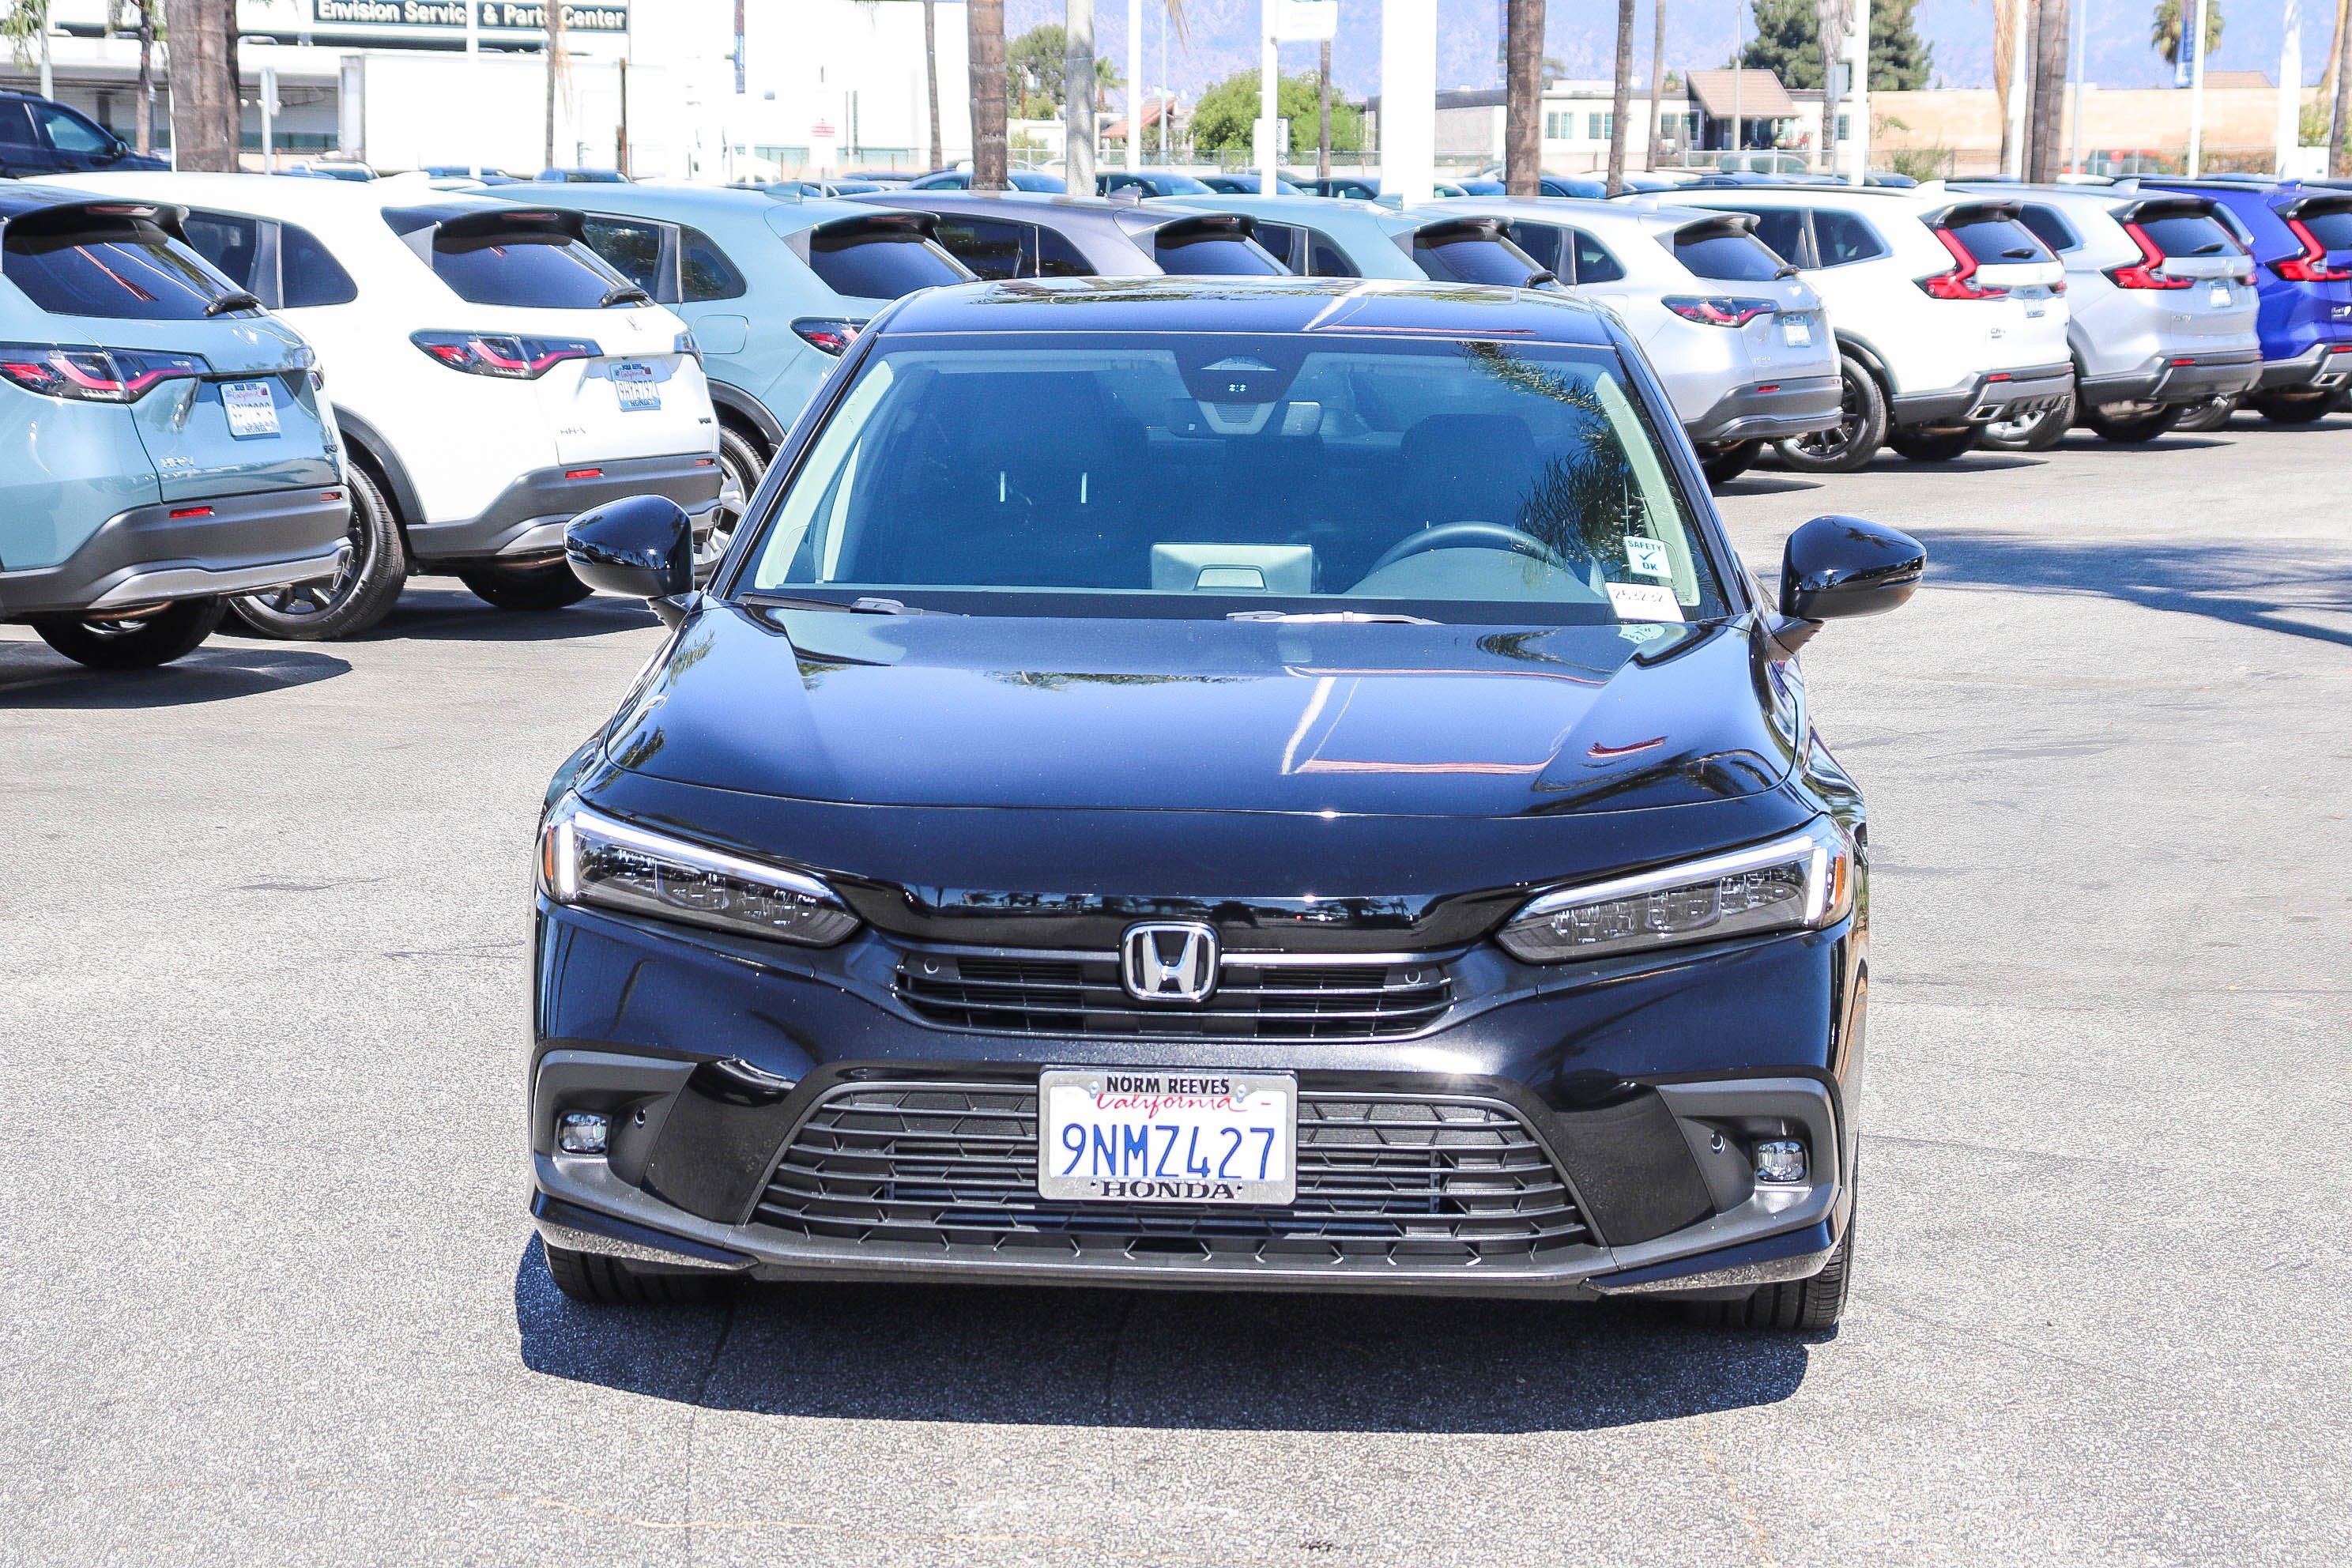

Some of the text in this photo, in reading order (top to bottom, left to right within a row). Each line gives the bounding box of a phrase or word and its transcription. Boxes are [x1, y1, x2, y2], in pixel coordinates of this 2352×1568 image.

[318, 0, 400, 22] Envision
[404, 0, 468, 24] Servic
[483, 3, 499, 26] &
[561, 5, 625, 31] Center
[1627, 540, 1662, 552] SAFETY
[1642, 562, 1658, 571] OK
[1106, 1076, 1230, 1095] NORM REEVES
[1096, 1093, 1247, 1119] California
[1062, 1122, 1276, 1180] 9NMZ427
[1101, 1180, 1235, 1200] HONDA
